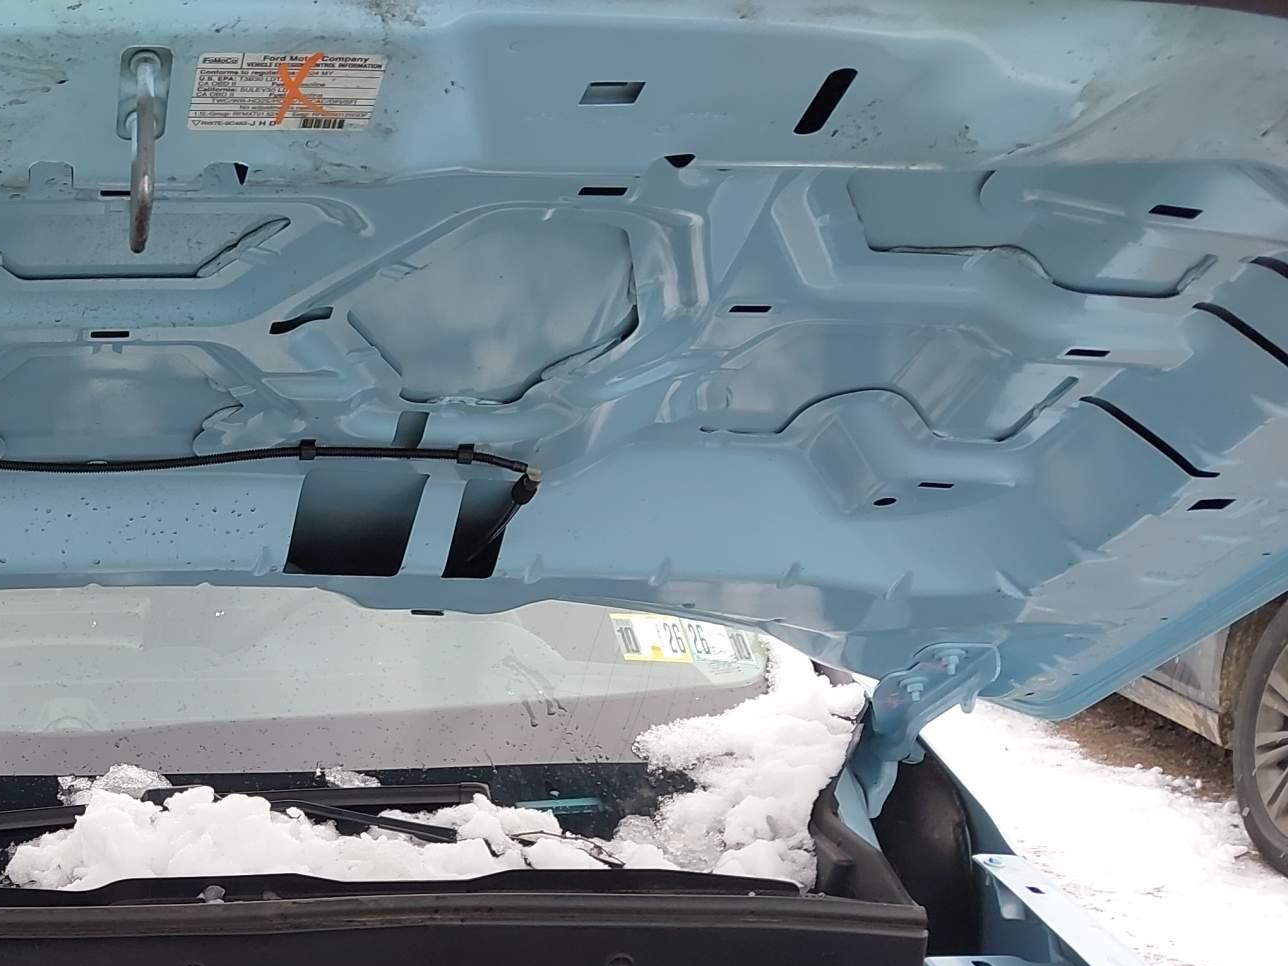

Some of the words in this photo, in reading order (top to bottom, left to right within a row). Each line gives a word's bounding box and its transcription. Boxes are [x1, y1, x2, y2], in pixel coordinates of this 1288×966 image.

[617, 626, 640, 654] 10
[663, 622, 686, 654] 26
[687, 623, 711, 655] 26
[729, 632, 754, 661] 10
